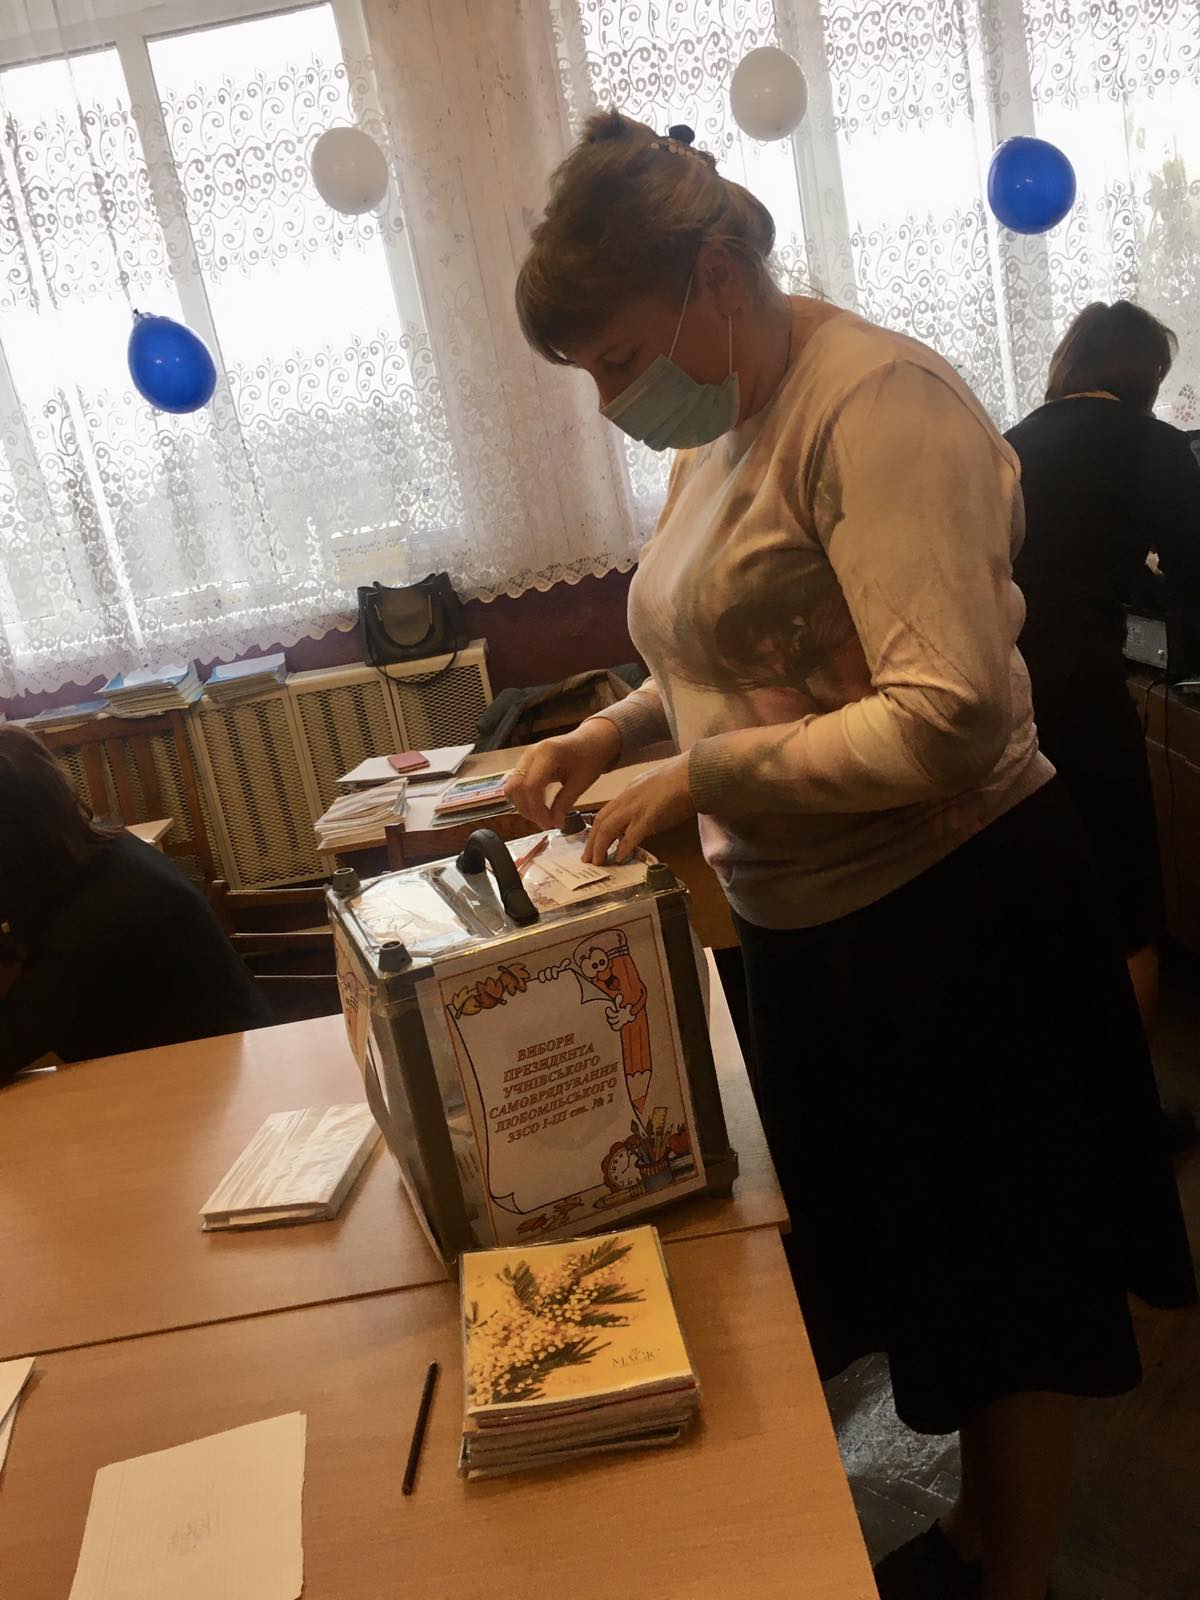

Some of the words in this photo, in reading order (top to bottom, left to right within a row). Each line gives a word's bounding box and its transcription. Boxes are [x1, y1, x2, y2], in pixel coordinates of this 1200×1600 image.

[503, 1042, 595, 1083] ПРЕЗИДЕНТА
[517, 1033, 575, 1062] ВИБОРИ
[488, 1061, 620, 1120] САМОВРЯДУВАННЯ
[503, 1055, 600, 1099] УЧНІВСЬКОГО
[494, 1077, 617, 1134] ЛЮБОМЛЬСЬКОГО
[507, 1122, 540, 1143] ЗЗСО
